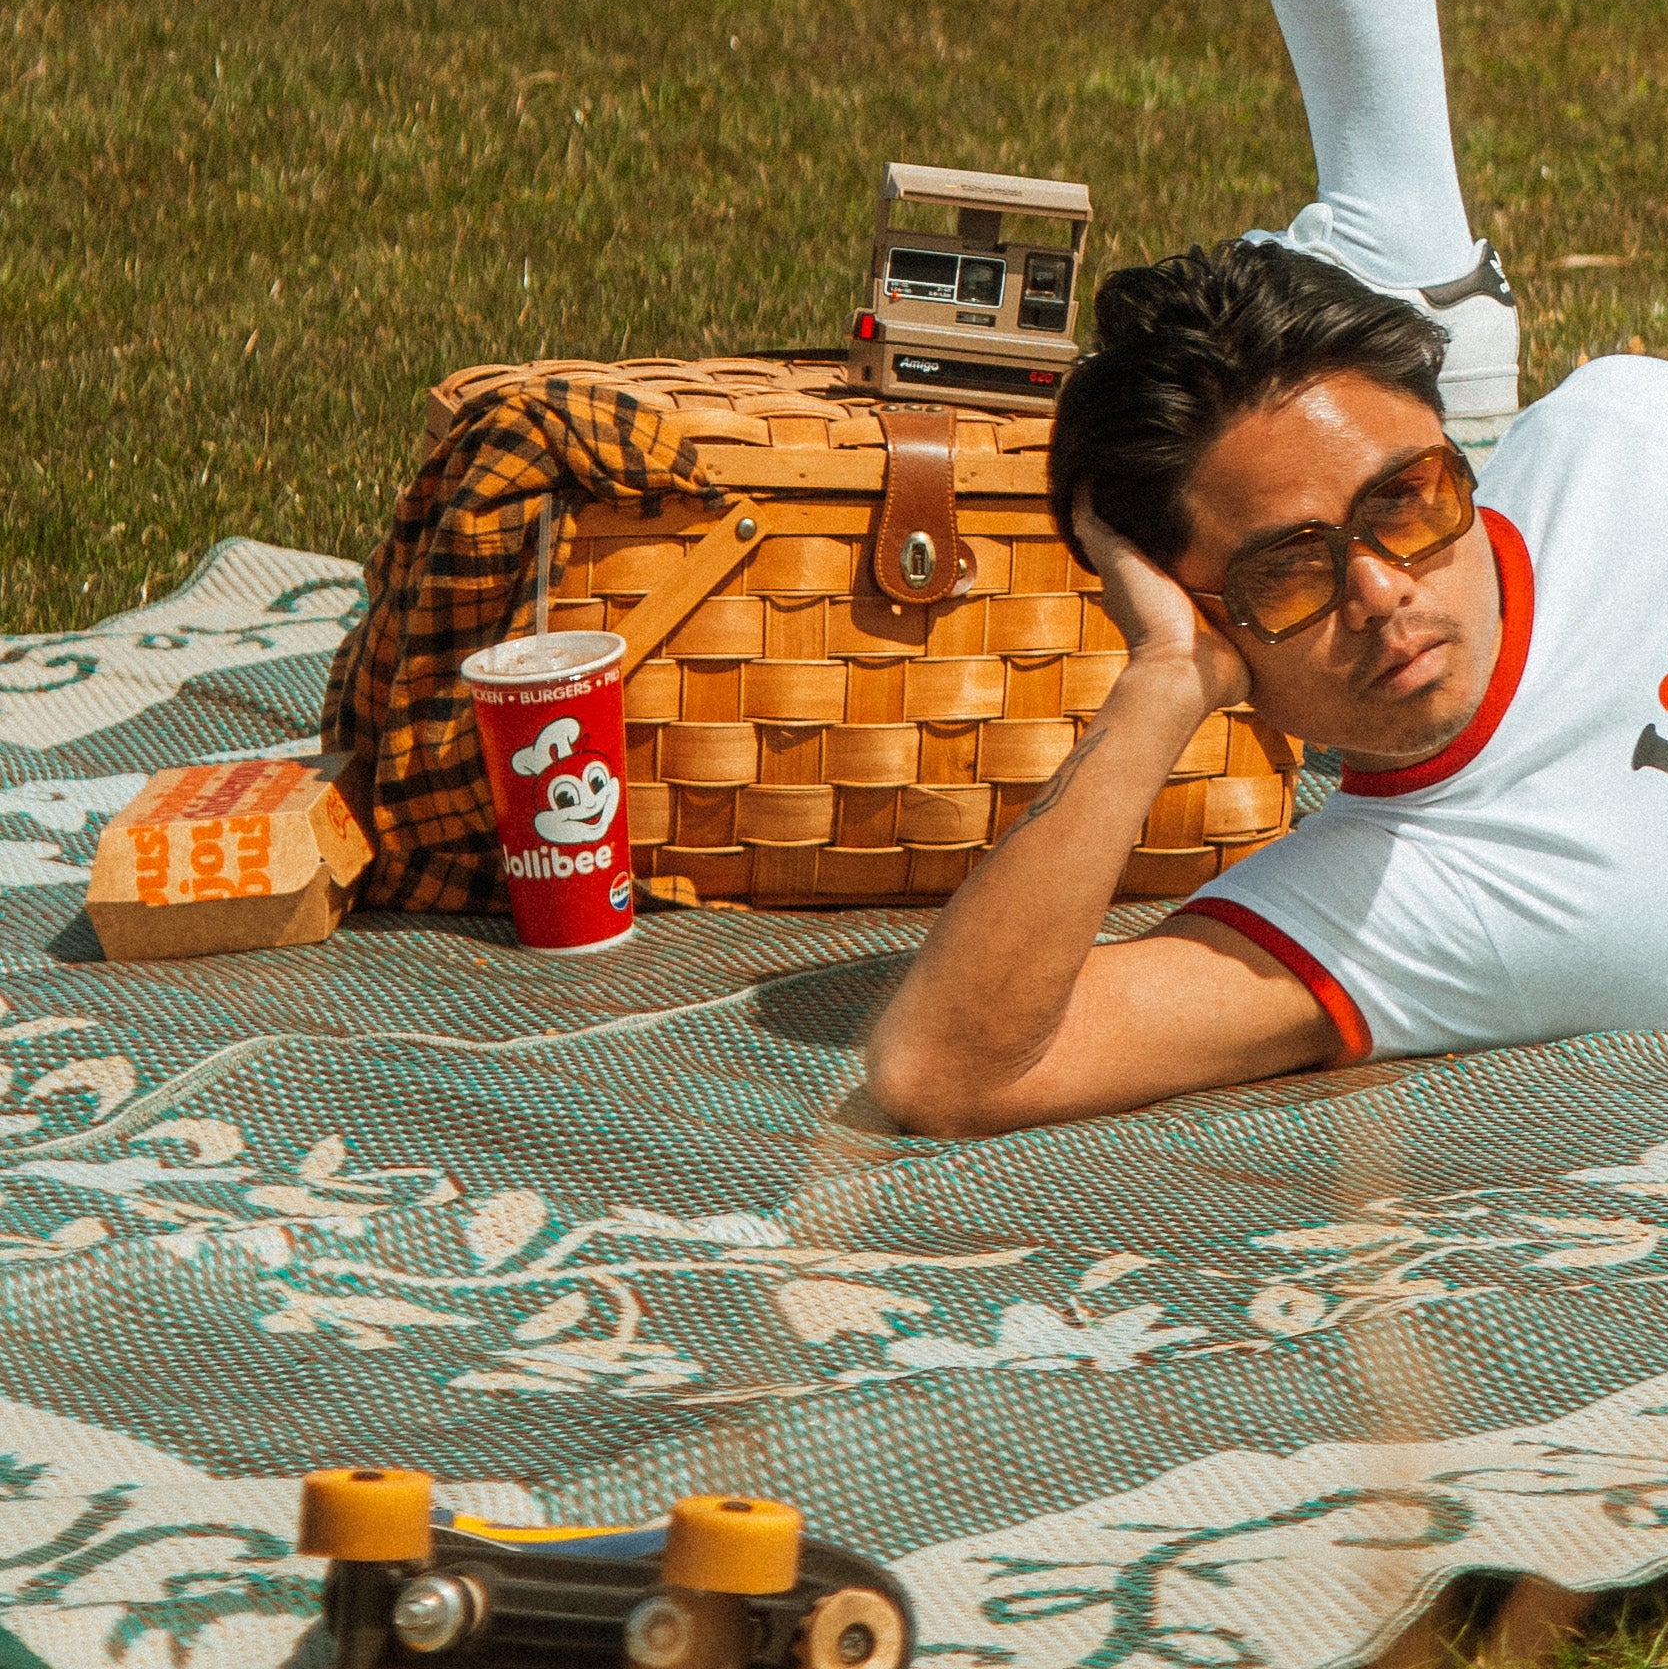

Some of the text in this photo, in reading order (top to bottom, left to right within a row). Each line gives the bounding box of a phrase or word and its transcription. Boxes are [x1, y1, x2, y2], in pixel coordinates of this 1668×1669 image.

[899, 356, 940, 373] Amigo
[1028, 370, 1055, 384] 620
[519, 679, 592, 705] BURGERS
[502, 843, 612, 880] Jollibee
